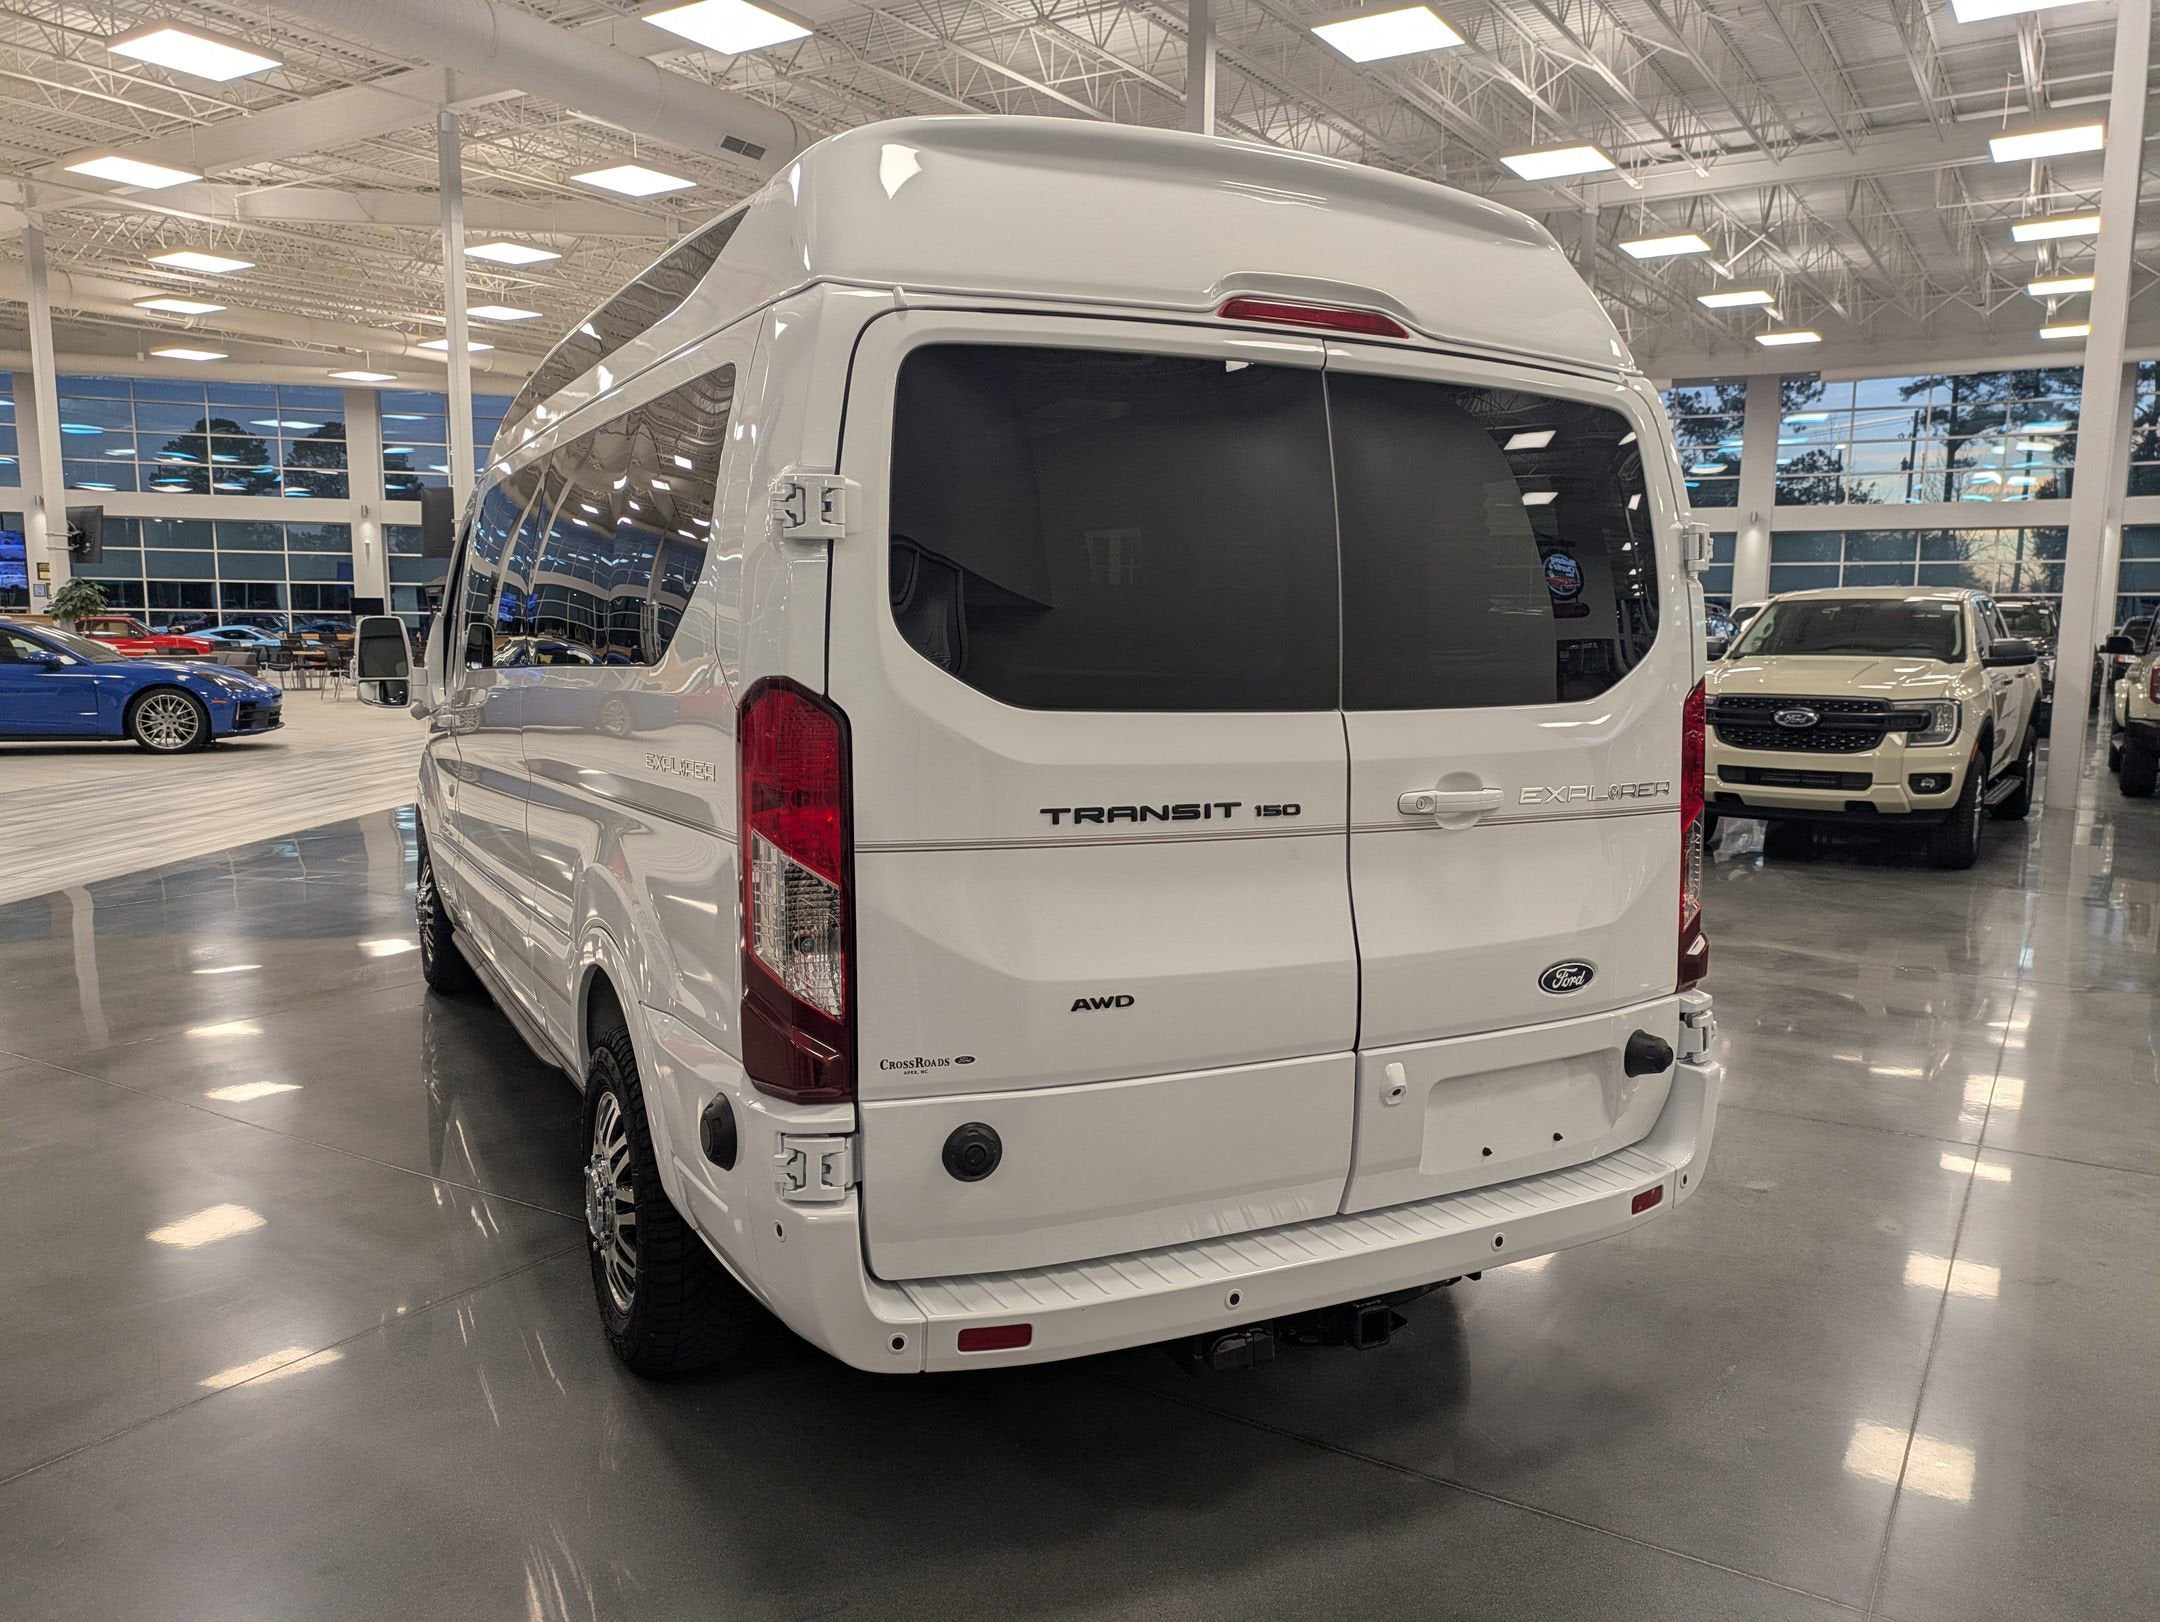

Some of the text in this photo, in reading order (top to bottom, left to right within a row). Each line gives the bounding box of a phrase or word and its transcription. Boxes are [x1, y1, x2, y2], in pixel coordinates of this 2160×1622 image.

[1519, 780, 1670, 804] EXPLORER
[1039, 801, 1301, 825] TRANSIT 150
[1552, 967, 1586, 989] Ford
[1070, 995, 1135, 1012] AWD
